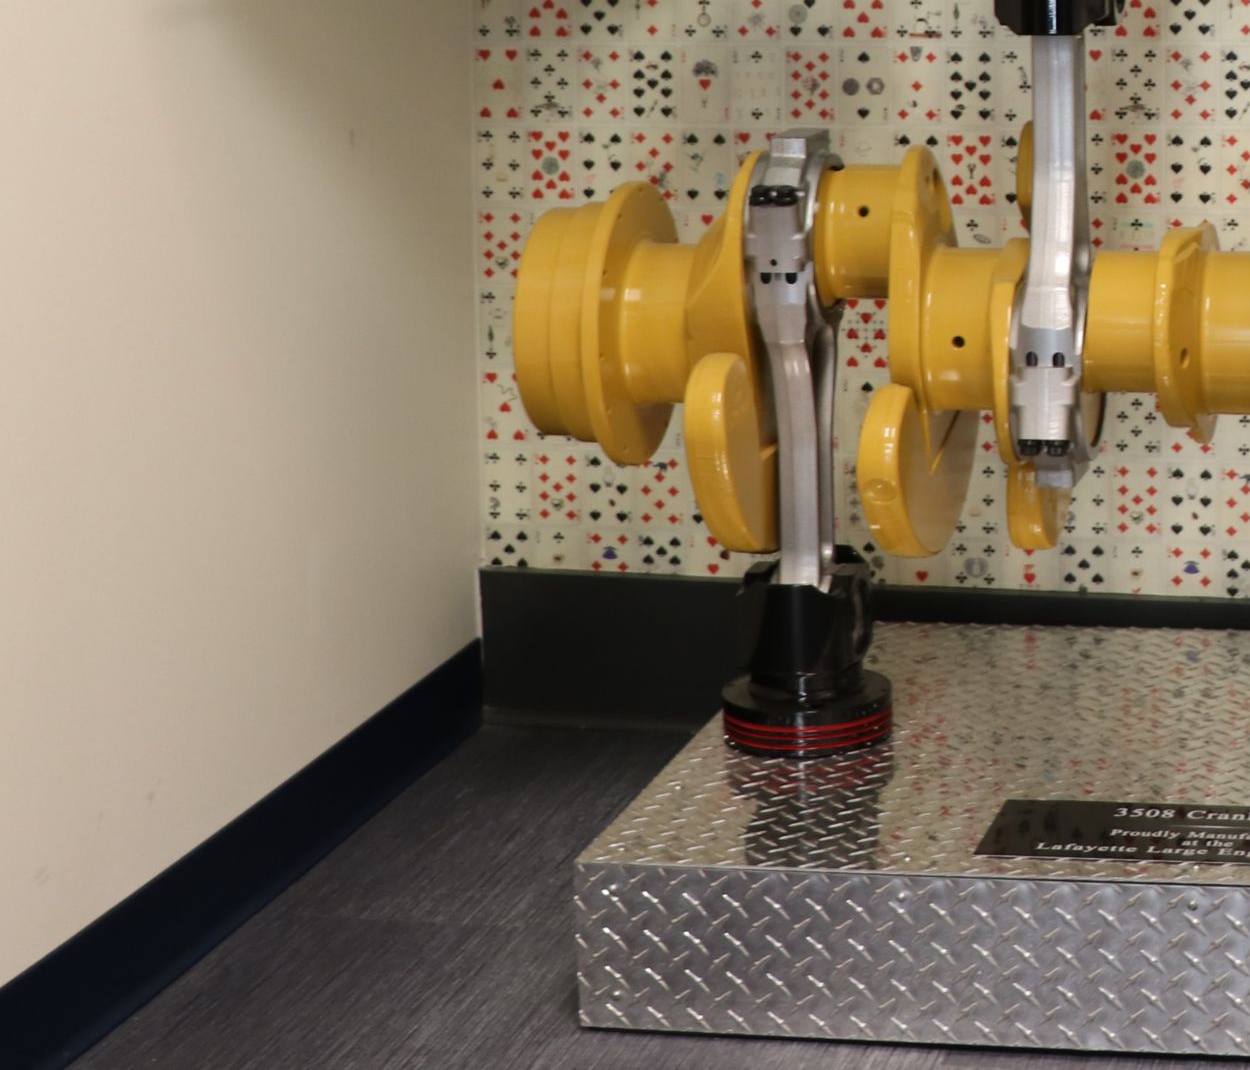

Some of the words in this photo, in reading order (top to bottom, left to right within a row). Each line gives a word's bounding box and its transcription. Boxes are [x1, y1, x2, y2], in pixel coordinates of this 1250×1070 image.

[1113, 807, 1176, 819] 3508
[1110, 828, 1182, 840] Proudly
[1035, 842, 1138, 853] Lafayette
[1146, 846, 1209, 857] Large
[1206, 840, 1235, 848] the
